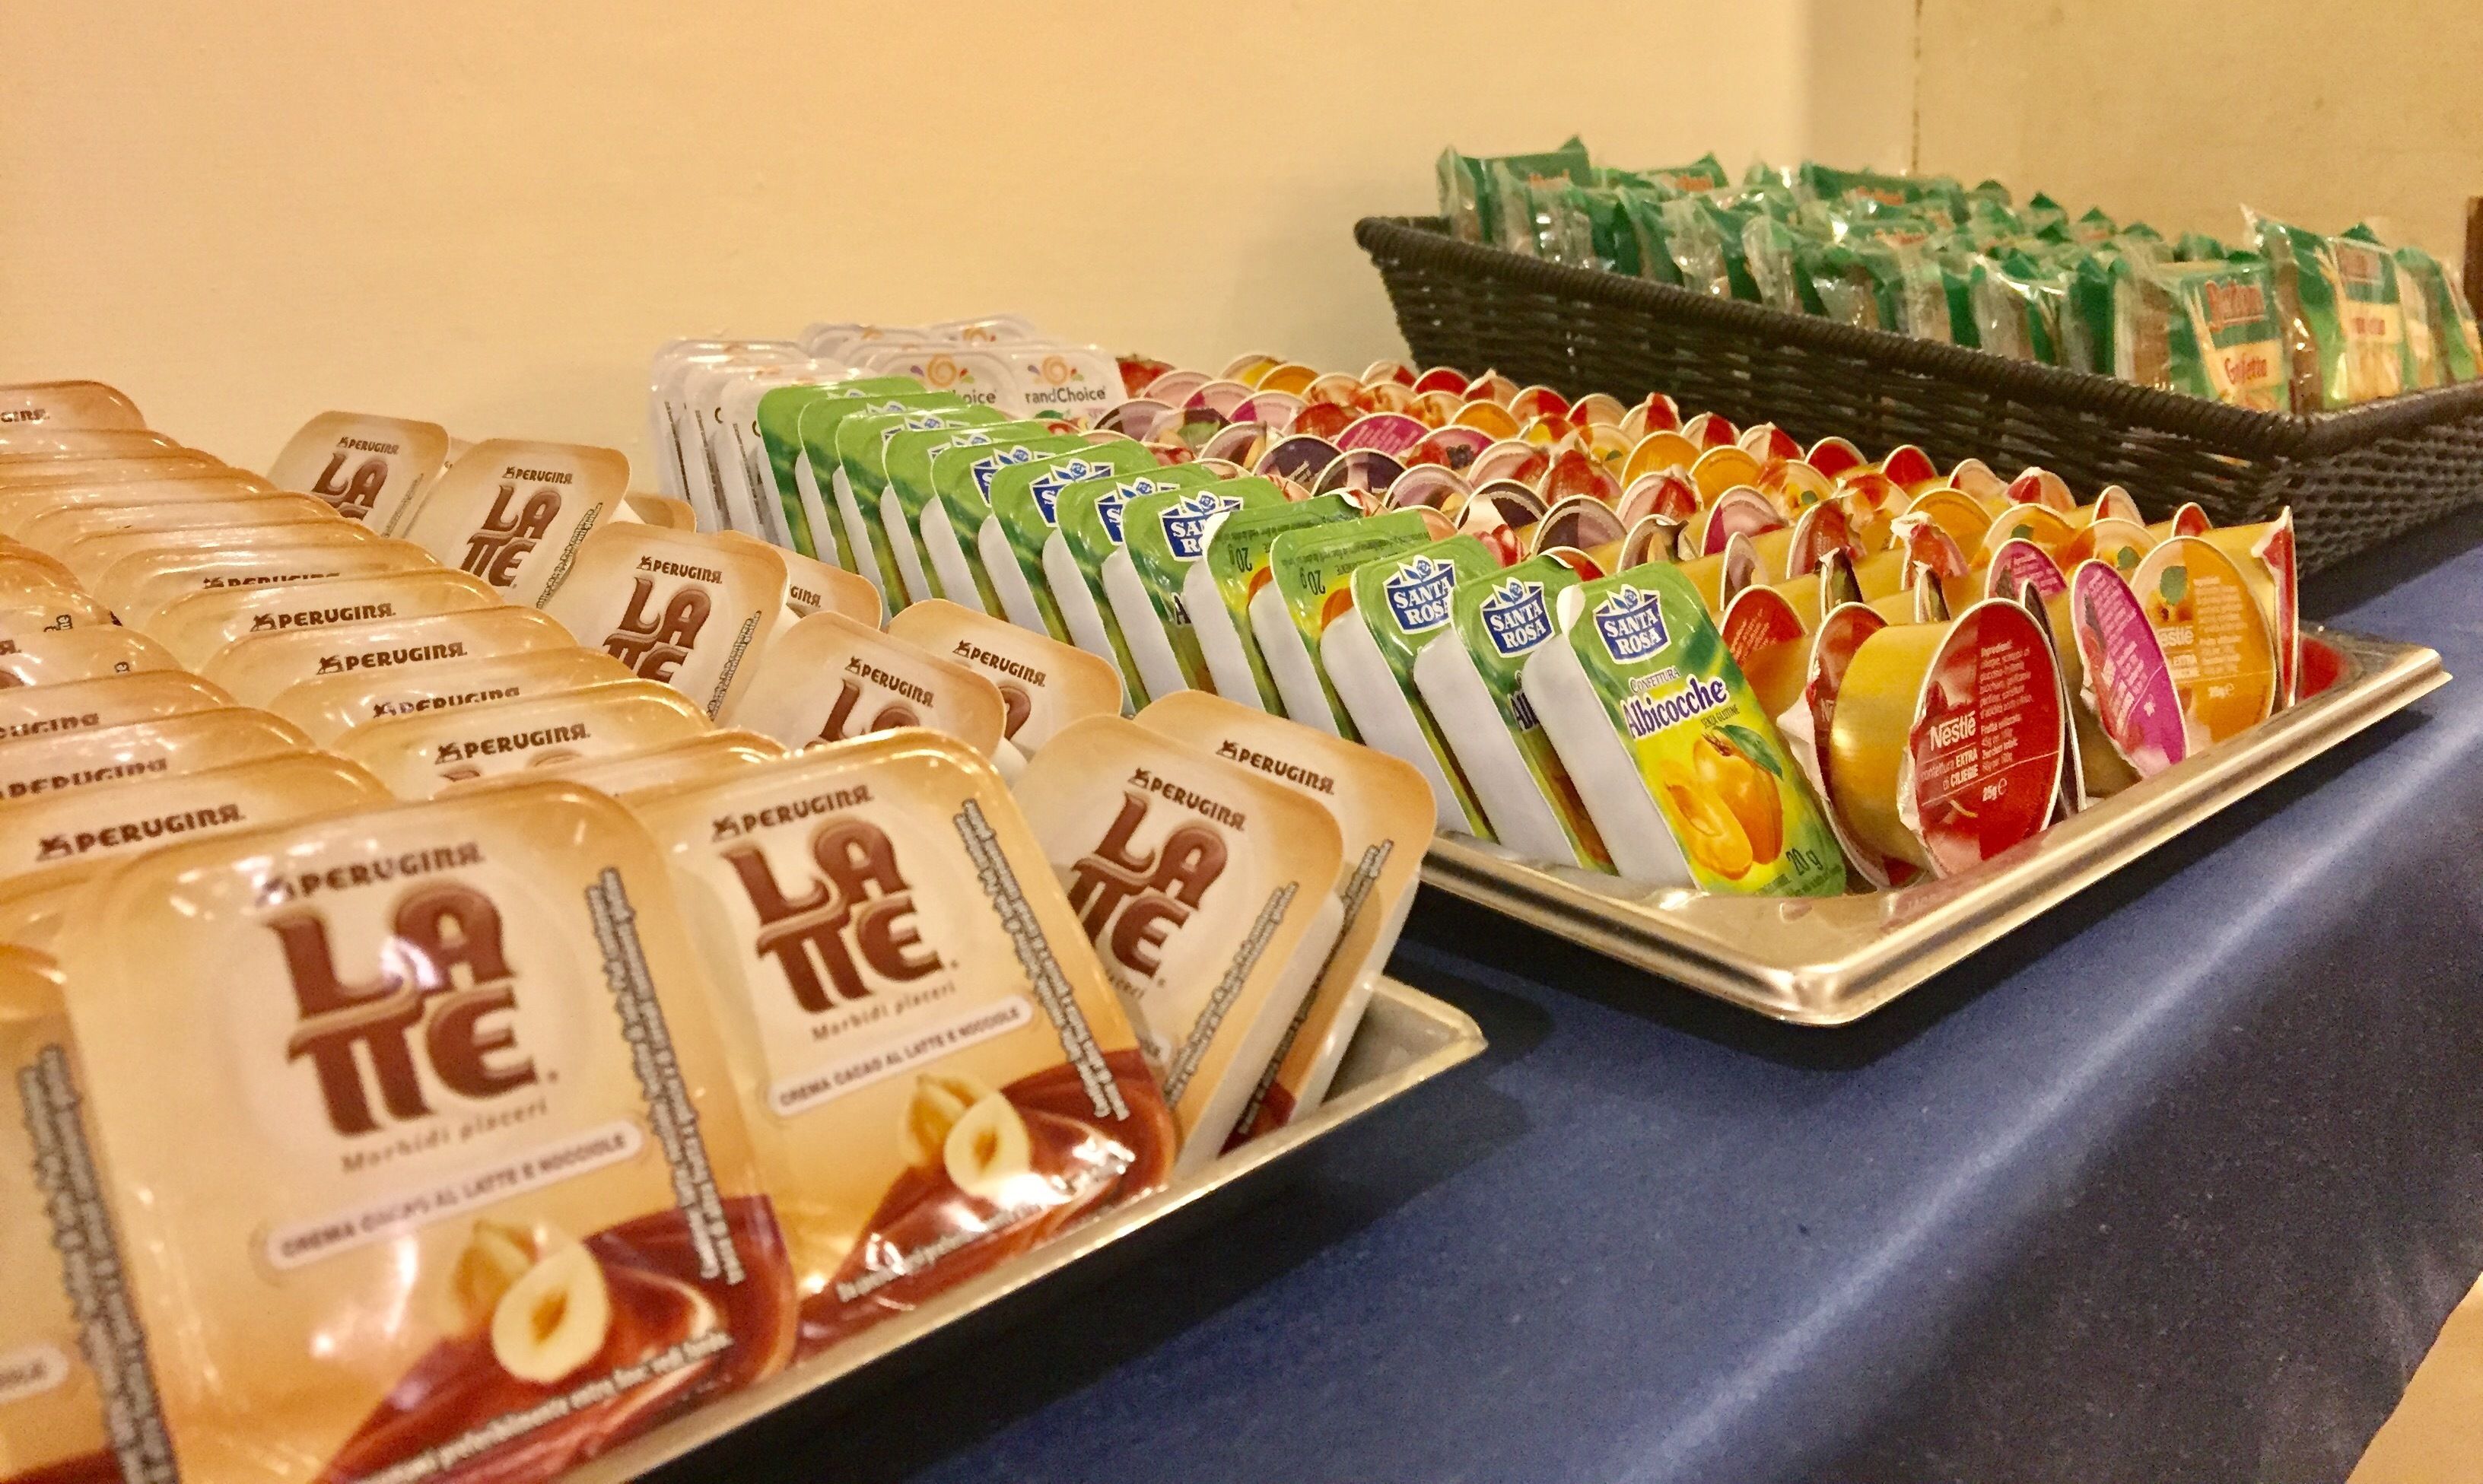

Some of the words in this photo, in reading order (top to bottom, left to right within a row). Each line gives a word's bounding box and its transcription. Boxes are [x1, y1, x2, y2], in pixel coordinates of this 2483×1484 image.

[515, 468, 574, 485] PERUGINA
[653, 559, 723, 584] PERUGINA
[1393, 577, 1451, 609] SANTA
[278, 602, 392, 629] PERUGINA
[1489, 599, 1544, 632] SANTA
[1501, 618, 1547, 649] ROSA
[1604, 609, 1659, 638] SANTA
[345, 641, 464, 671] PERUGINA
[1615, 628, 1663, 656] ROSA
[861, 663, 934, 707] PERUGINA
[970, 647, 1047, 687] PERUGINA
[1623, 677, 1728, 739] Albicocche
[464, 723, 589, 758] PERUGINA
[1929, 710, 1976, 752] Nestlé
[1237, 747, 1334, 796] PERUGINA
[743, 784, 872, 832] PERUGINA
[1150, 776, 1247, 831] PERUGINA
[76, 802, 239, 853] PERUGINA
[301, 841, 483, 898] PERUGINA
[812, 1004, 892, 1042] Morbidi
